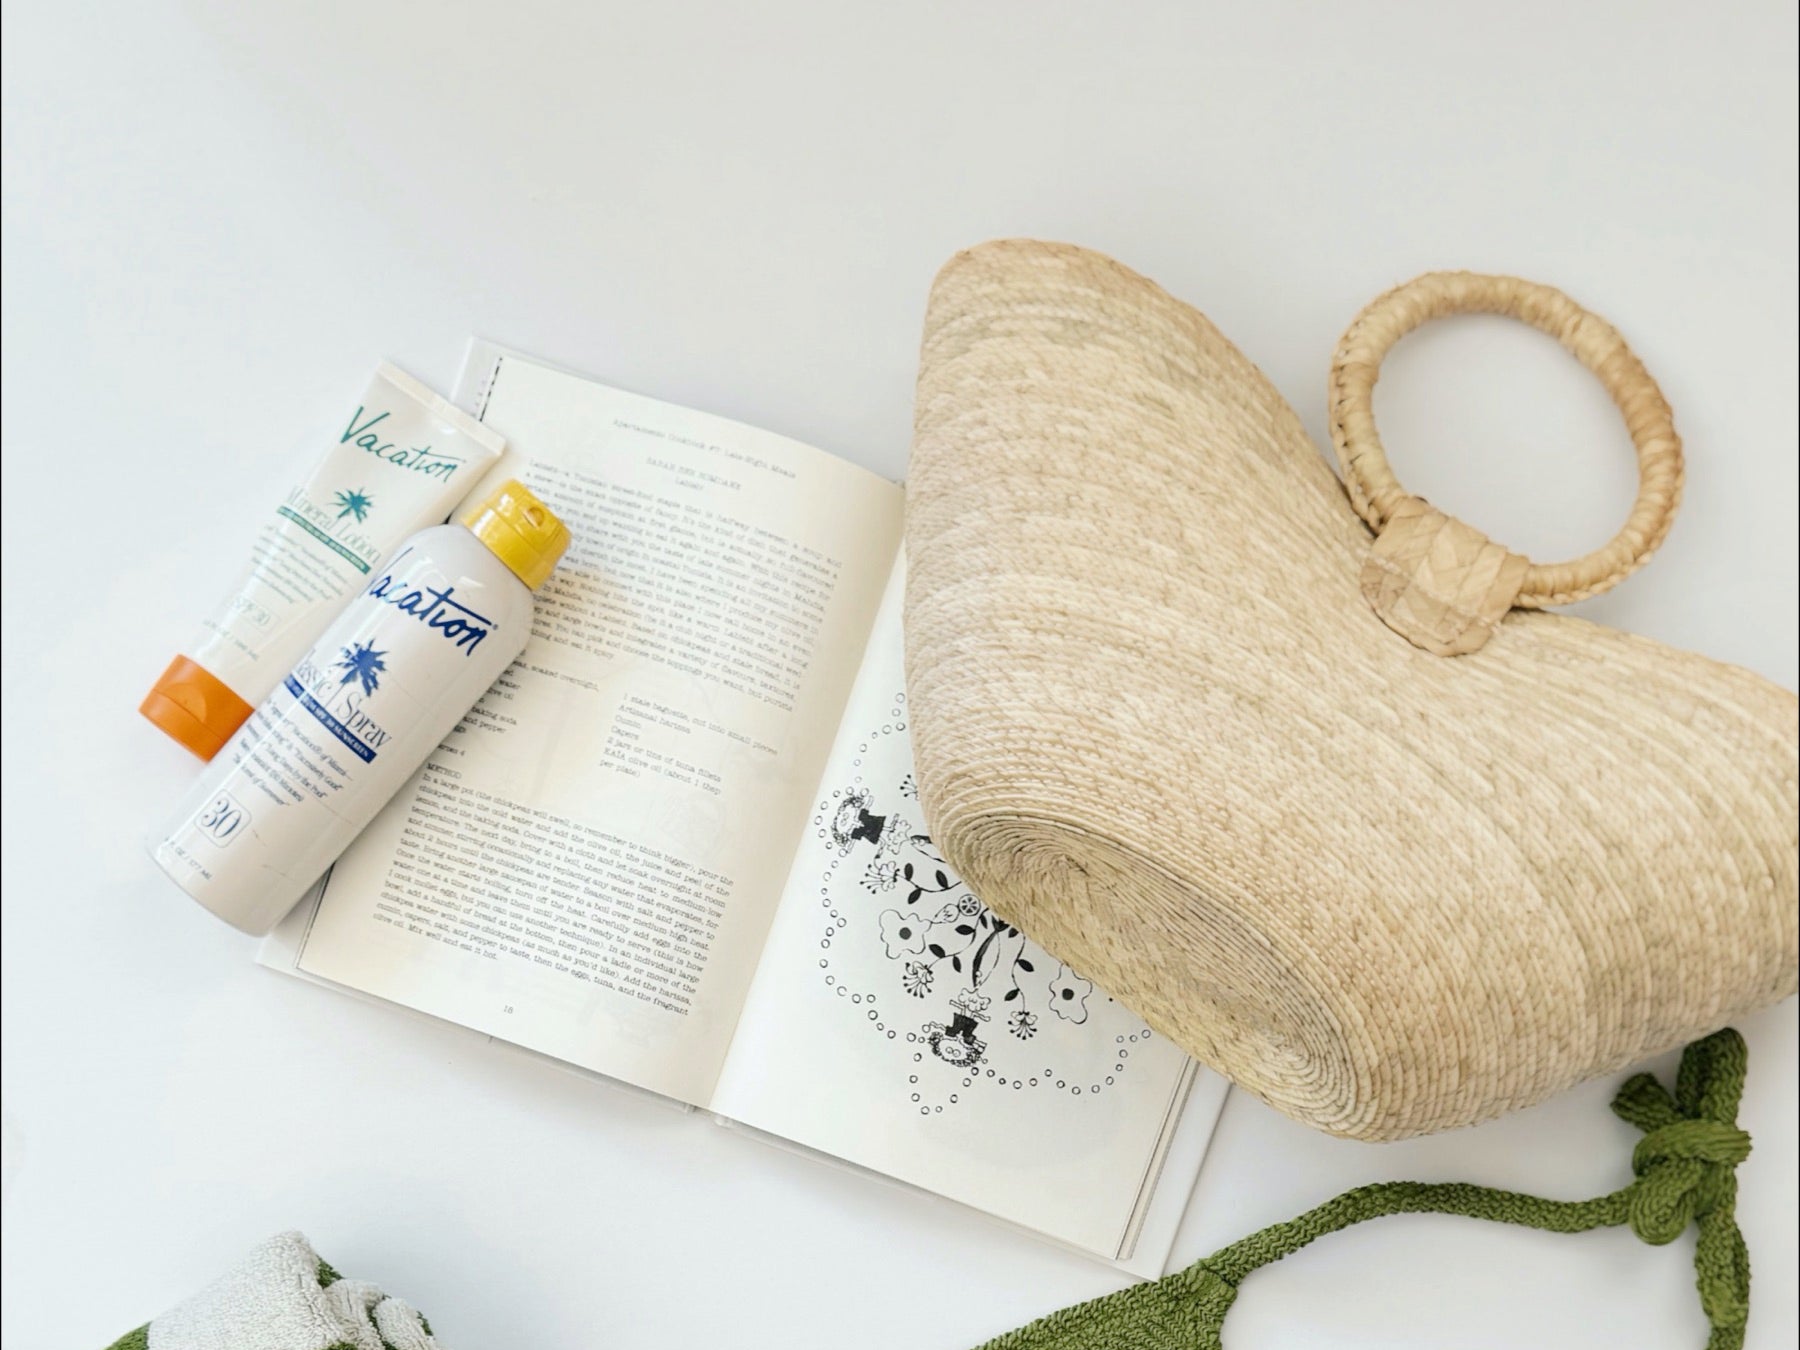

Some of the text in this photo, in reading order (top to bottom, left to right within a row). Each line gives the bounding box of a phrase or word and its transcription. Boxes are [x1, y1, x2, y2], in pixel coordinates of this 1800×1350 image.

[341, 406, 466, 482] Vacation
[336, 523, 380, 563] Lotion
[332, 724, 371, 758] SUNSCREEN
[336, 690, 393, 750] Spray
[426, 762, 461, 779] METHOD
[201, 798, 243, 838] 30
[615, 861, 725, 908] let soak overnight room
[626, 853, 730, 896] the juice and peel the
[639, 846, 733, 886] think bigger), pour the
[583, 887, 612, 902] Season
[616, 899, 634, 910] with
[637, 907, 653, 917] salt
[655, 914, 672, 924] and
[674, 922, 703, 935] pepper
[706, 932, 715, 940] to
[607, 872, 722, 918] reduce heat medium-low
[611, 886, 719, 929] water that evaporates, for
[591, 915, 629, 933] Carefully
[633, 931, 649, 940] add
[652, 938, 670, 948] eggs
[673, 944, 690, 955] into
[694, 952, 707, 961] the
[594, 903, 609, 914] boil
[611, 911, 630, 920] over
[633, 918, 666, 934] medium
[669, 930, 687, 942] high
[690, 939, 709, 950] heat.
[560, 928, 603, 949] technique).
[634, 954, 676, 974] individual
[679, 970, 699, 983] large
[579, 949, 599, 959] pour
[611, 958, 631, 970] ladle
[646, 972, 668, 984] more
[682, 984, 696, 993] the
[589, 927, 703, 972] ready serve (this how
[571, 970, 688, 1015] eggs, tuna, and the fragrant
[573, 958, 597, 970] you'd
[599, 966, 619, 979] like).
[623, 975, 641, 986] Add
[643, 982, 656, 992] the
[659, 988, 691, 1006] harissa,
[503, 1004, 513, 1014] 18
